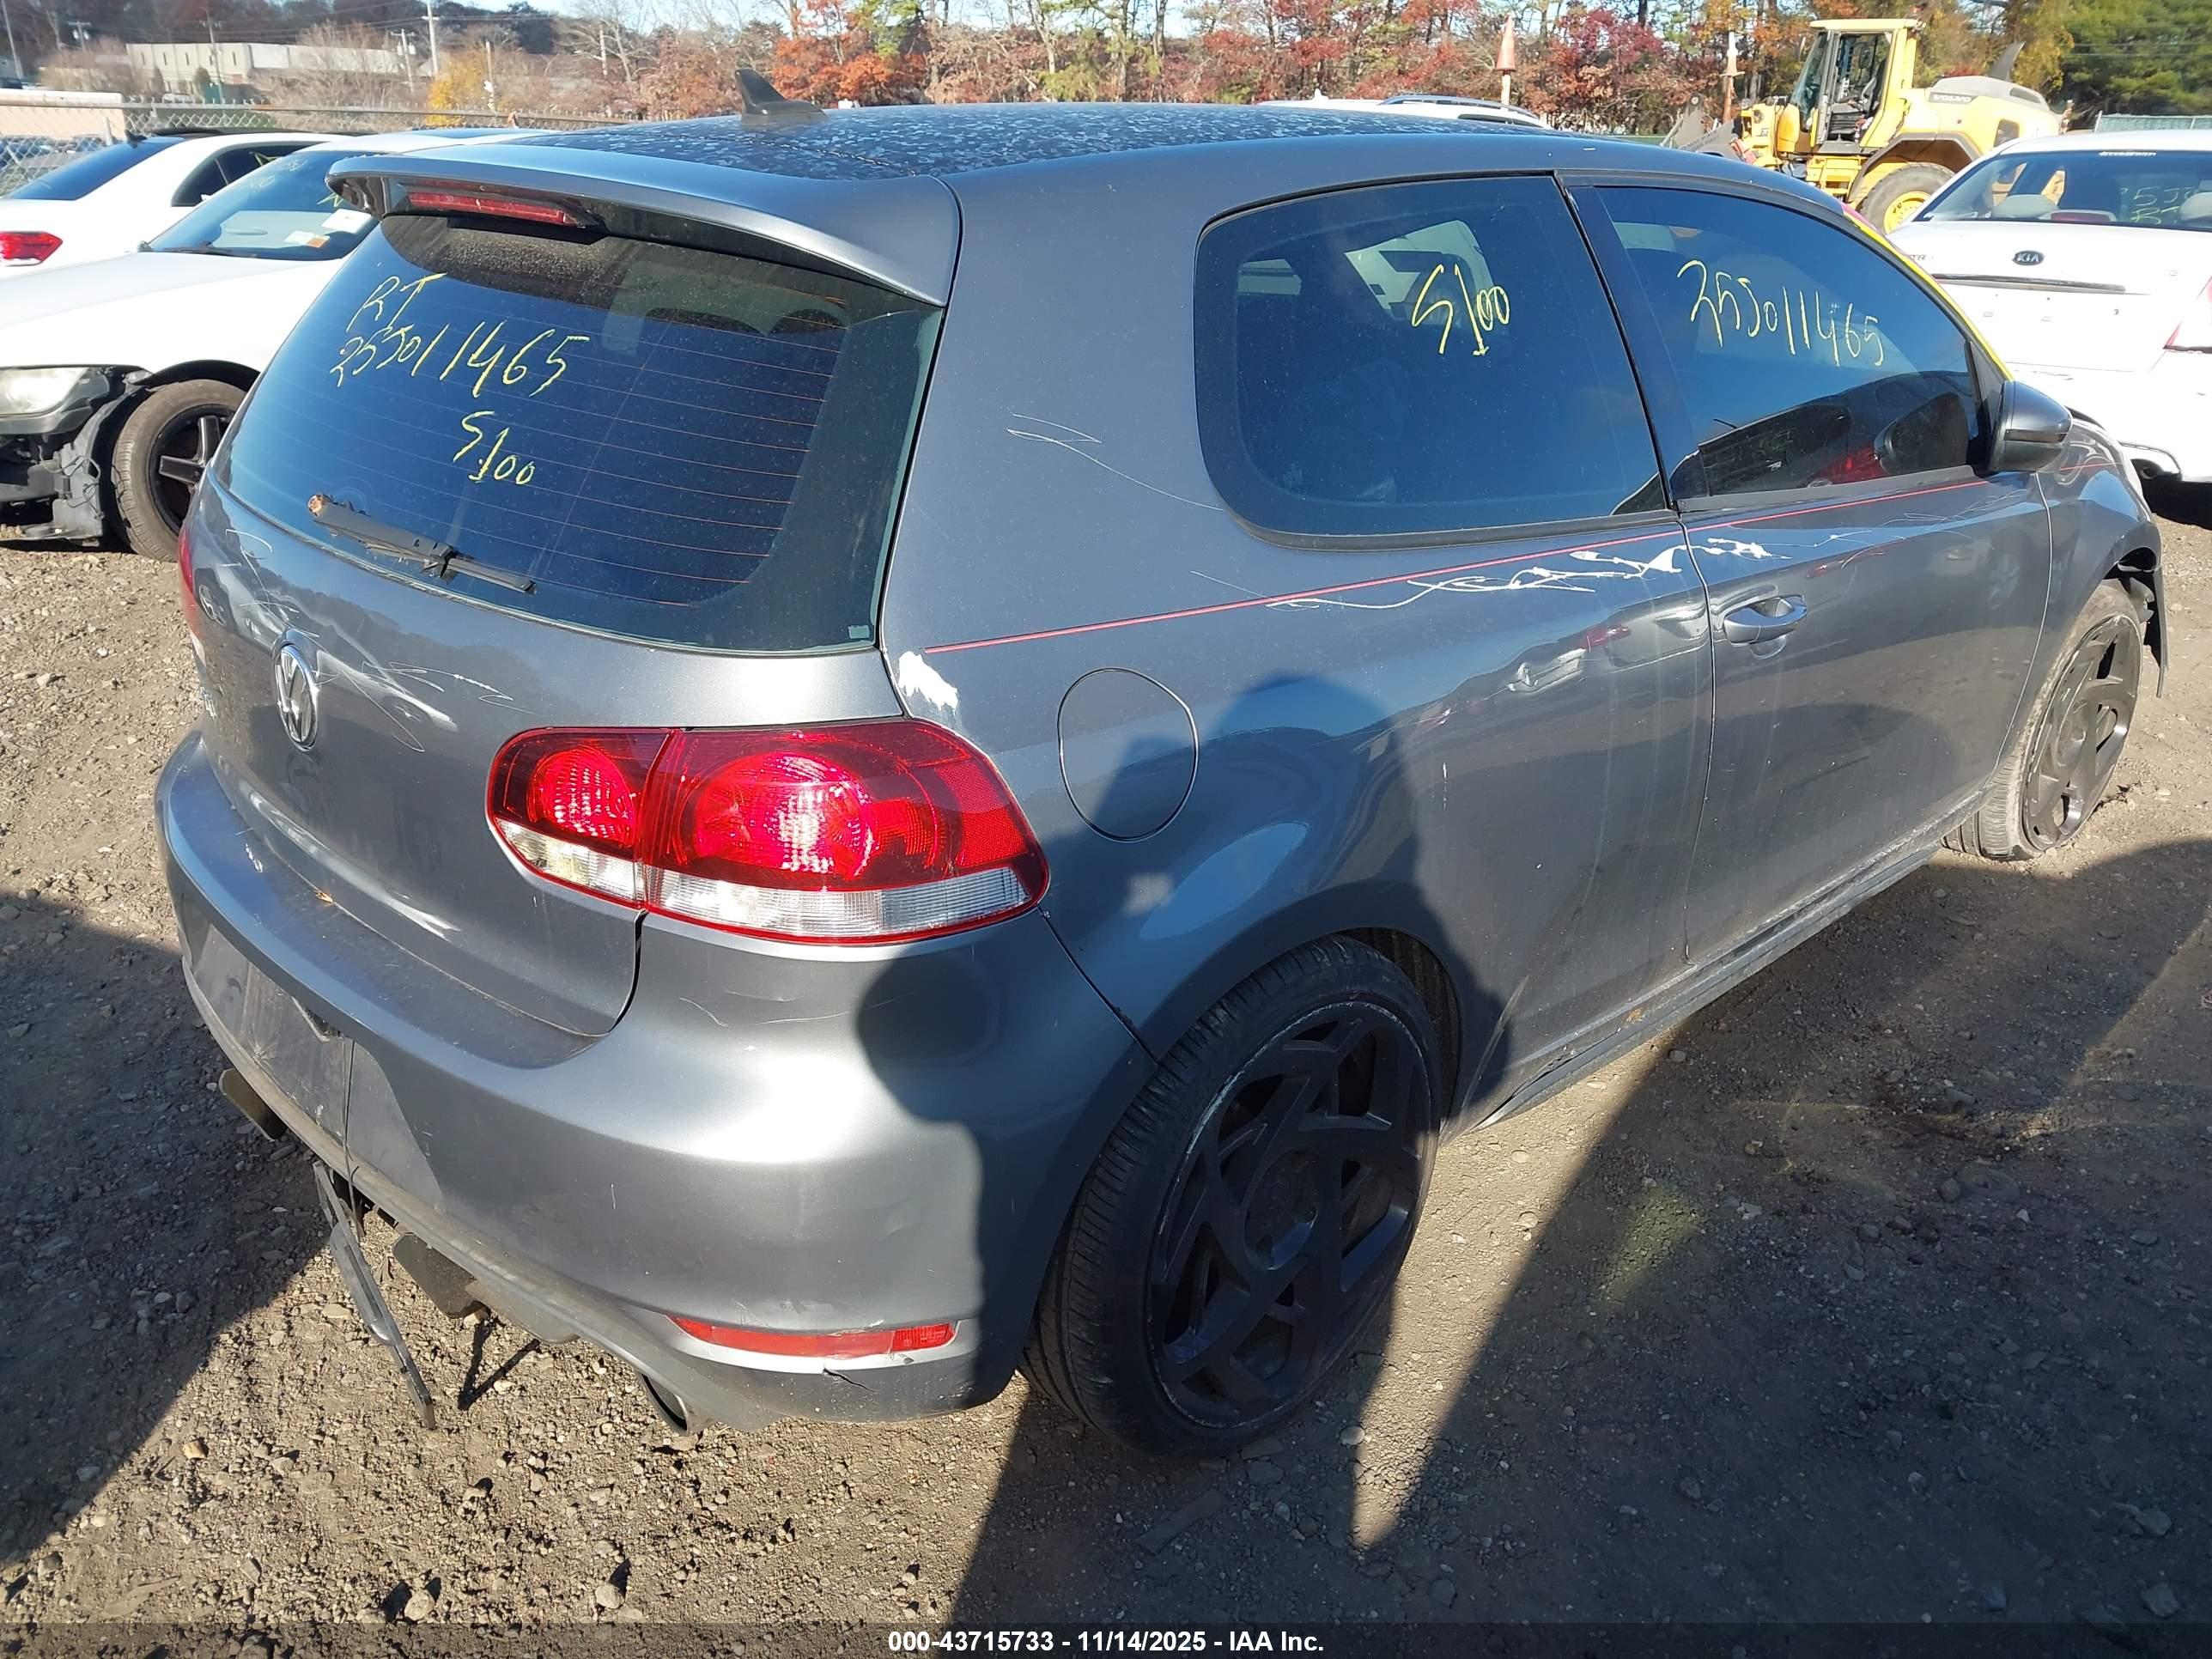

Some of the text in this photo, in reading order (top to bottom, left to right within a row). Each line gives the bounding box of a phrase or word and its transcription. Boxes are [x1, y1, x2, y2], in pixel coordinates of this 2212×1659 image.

[1933, 94, 1972, 103] VOLVO
[2017, 252, 2041, 263] KIA
[346, 272, 448, 332] RT
